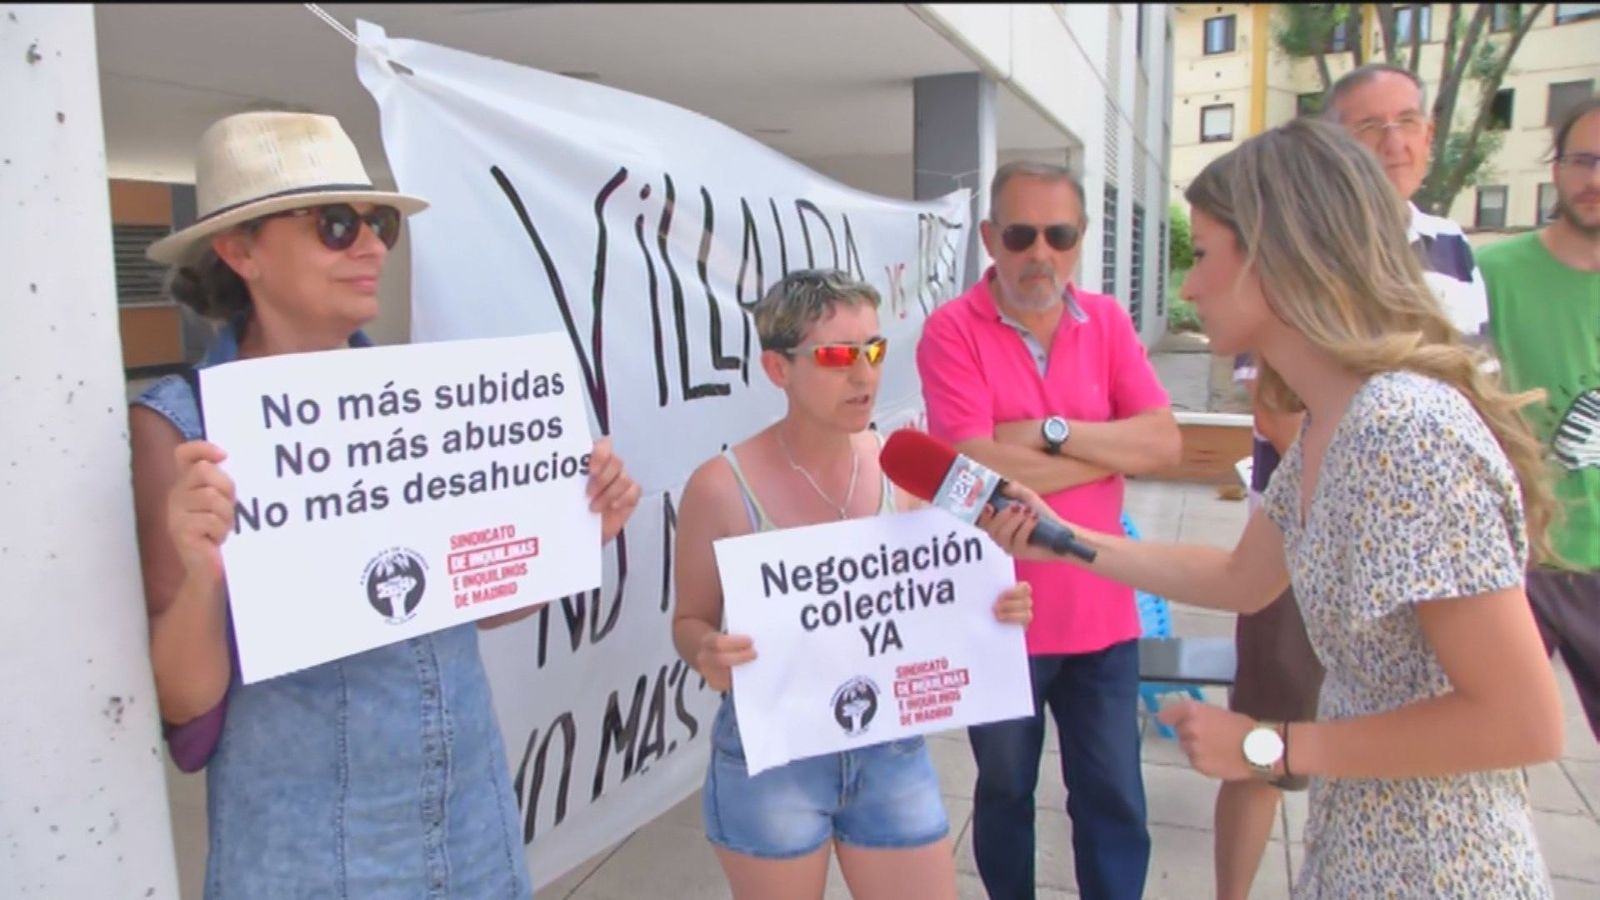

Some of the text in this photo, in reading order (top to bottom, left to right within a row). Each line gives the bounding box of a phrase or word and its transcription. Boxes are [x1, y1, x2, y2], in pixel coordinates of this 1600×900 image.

[261, 369, 565, 430] No más subidas
[275, 416, 563, 478] No más abusos
[233, 451, 592, 535] No más desahucios
[450, 524, 516, 550] SINDICATO
[760, 531, 983, 598] Negociación
[455, 581, 518, 609] DE MADRID
[462, 562, 528, 588] INQUILINOS
[800, 577, 955, 632] colectiva
[859, 619, 904, 658] YA
